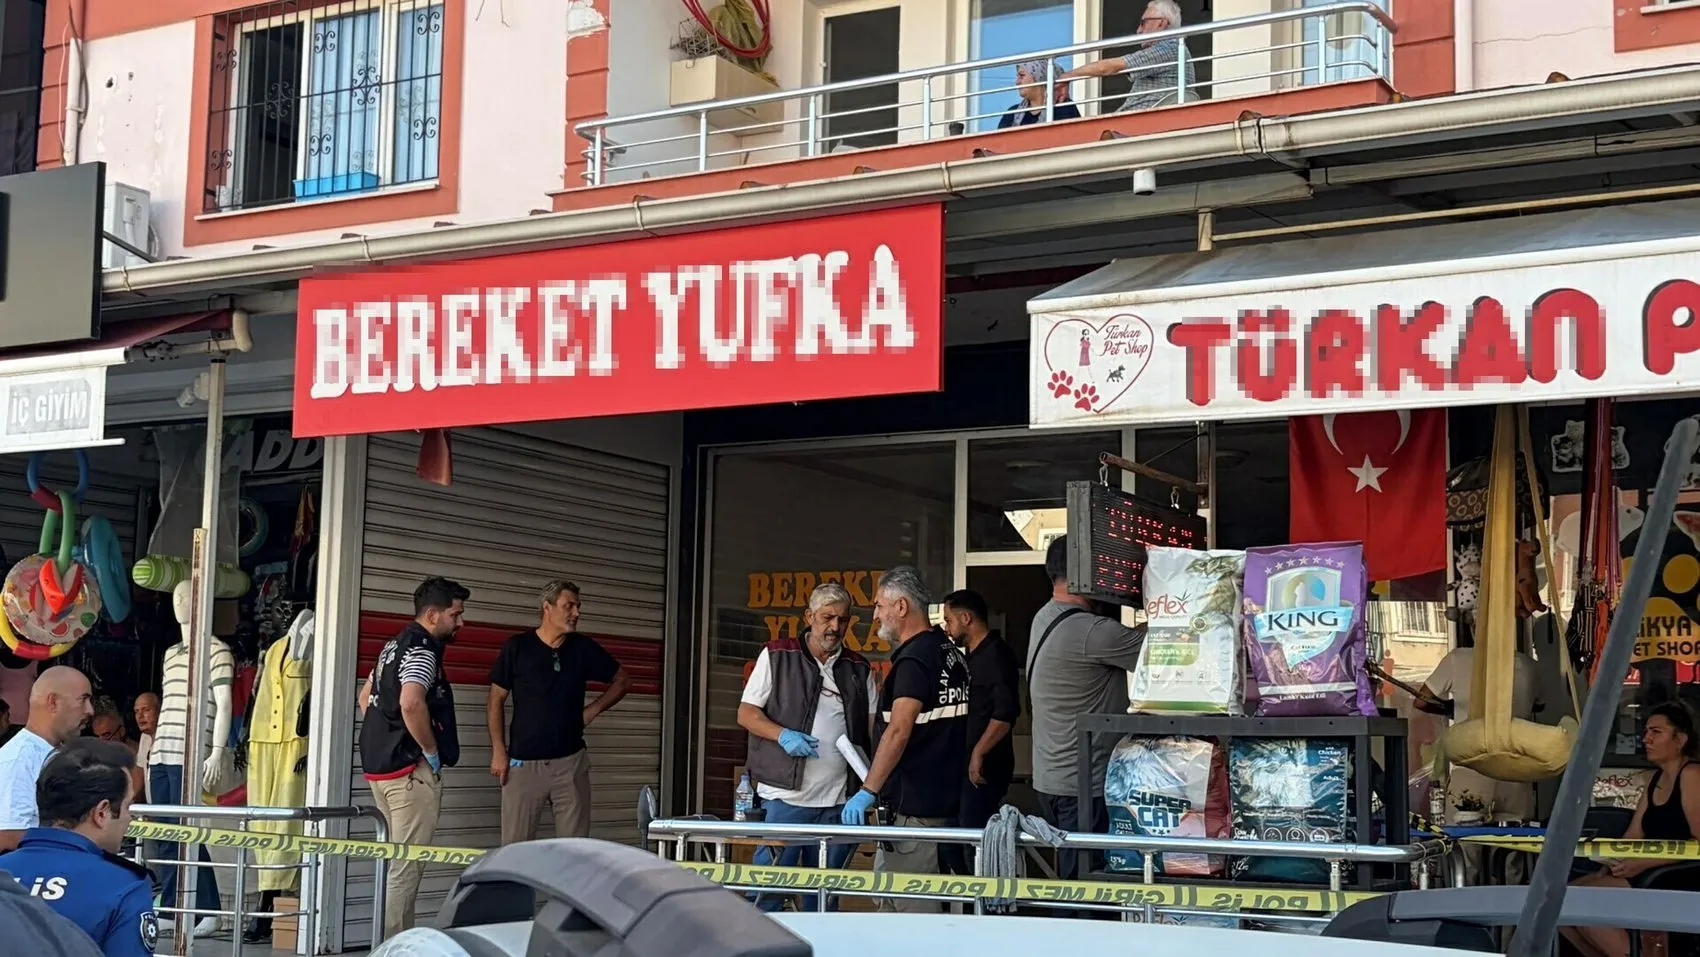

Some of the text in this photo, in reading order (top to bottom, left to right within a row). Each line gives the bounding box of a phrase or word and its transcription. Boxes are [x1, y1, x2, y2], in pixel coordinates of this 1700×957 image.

[311, 244, 917, 398] BEREKET YUFKA
[1099, 339, 1149, 359] Pet Shop
[1166, 287, 1607, 407] TÜRKAN
[35, 386, 89, 423] GİYİM
[1267, 610, 1339, 632] KING
[1637, 615, 1693, 638] İKYA
[1128, 788, 1192, 810] SUPER
[1137, 806, 1184, 828] CAT
